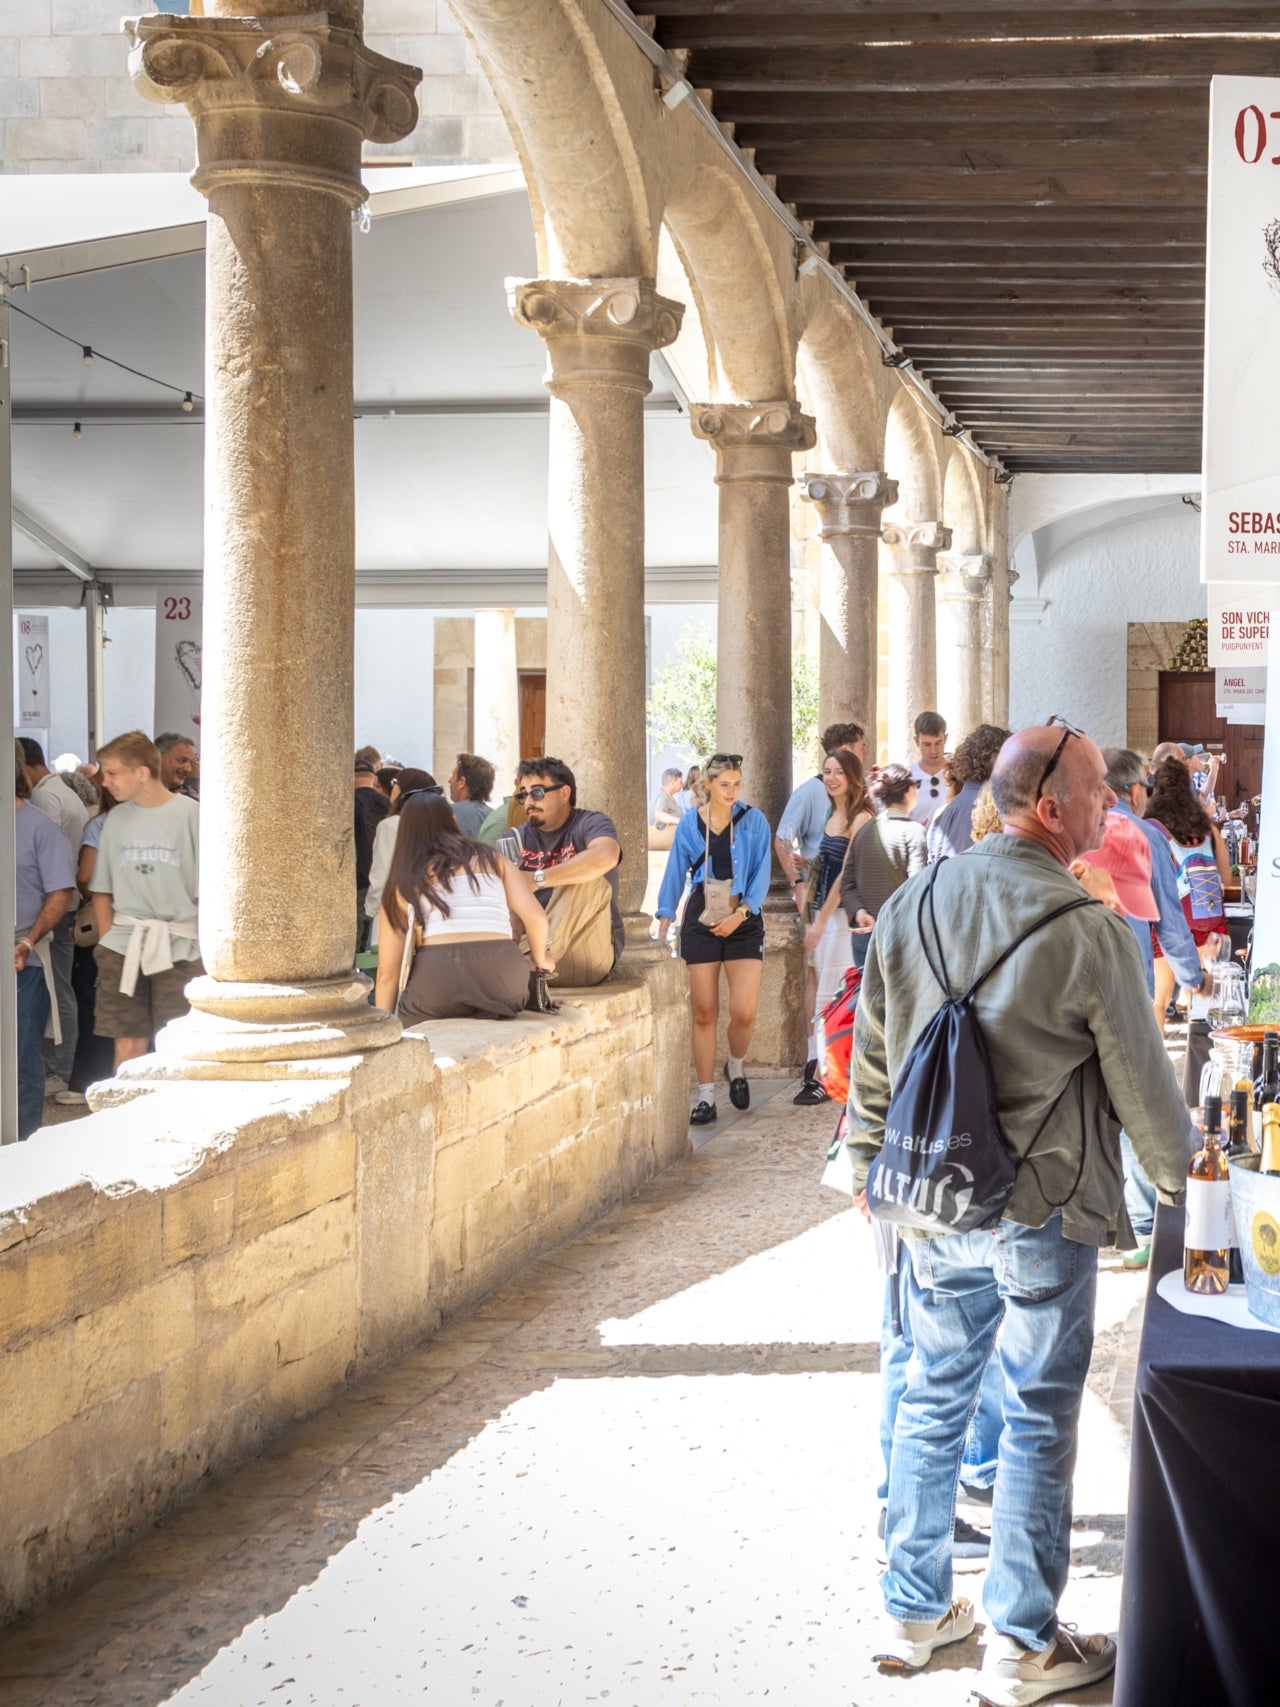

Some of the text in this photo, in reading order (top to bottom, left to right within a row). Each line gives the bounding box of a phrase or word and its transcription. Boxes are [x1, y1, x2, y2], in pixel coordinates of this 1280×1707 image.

[1227, 540, 1250, 554] STA.
[164, 596, 191, 620] 23
[1221, 611, 1270, 624] SON VICH
[1222, 626, 1235, 639] DE
[1223, 675, 1246, 687] ÀNGEL
